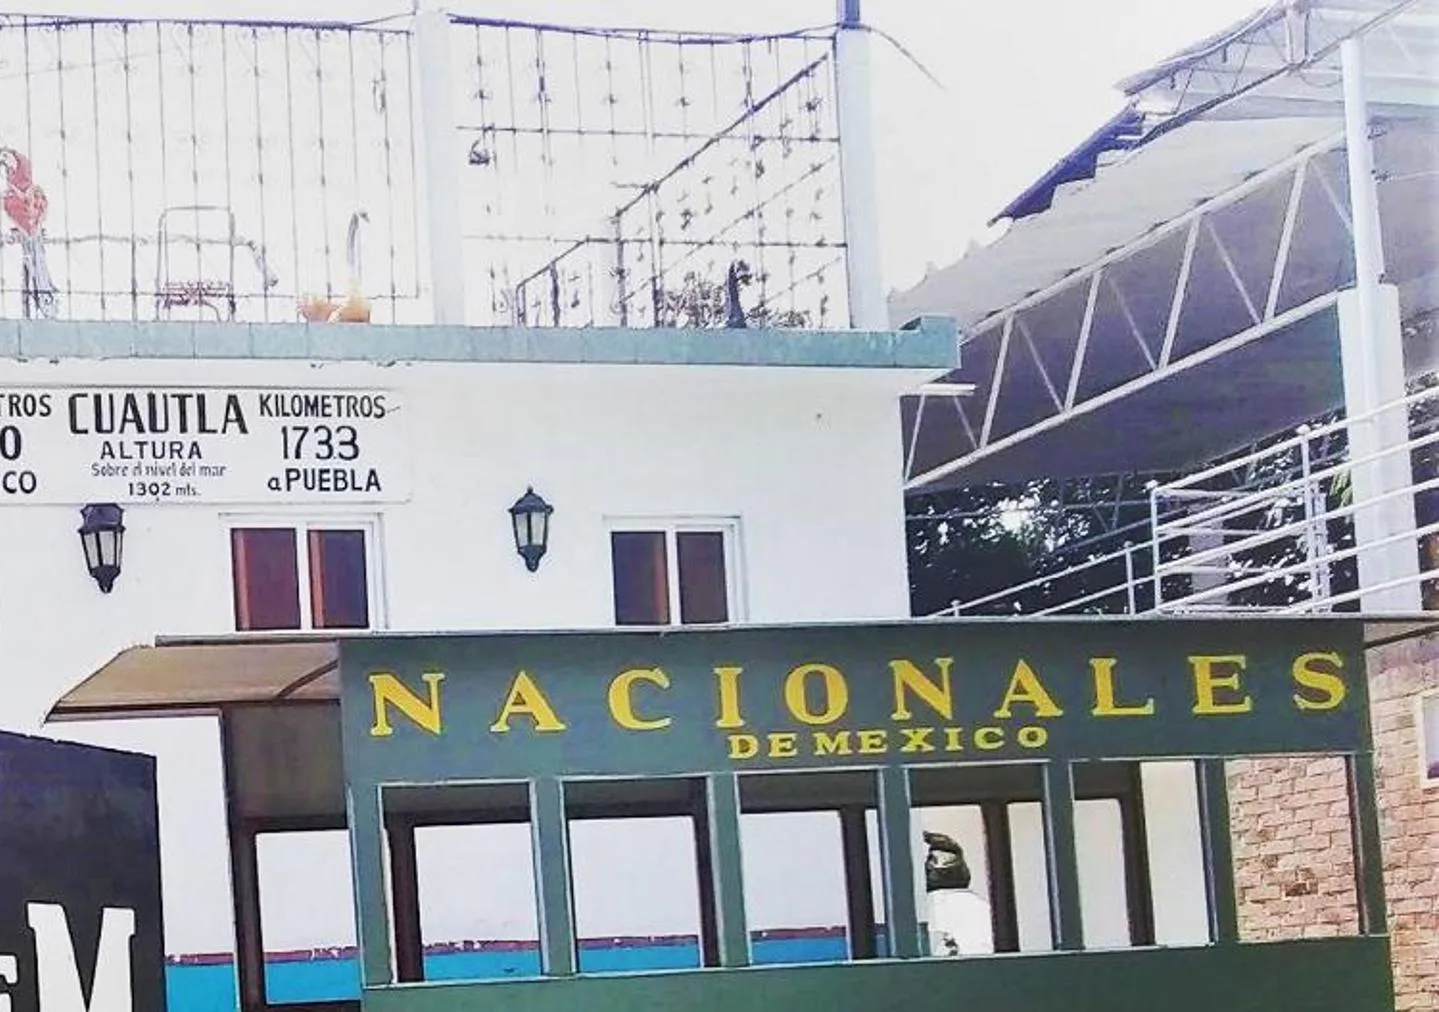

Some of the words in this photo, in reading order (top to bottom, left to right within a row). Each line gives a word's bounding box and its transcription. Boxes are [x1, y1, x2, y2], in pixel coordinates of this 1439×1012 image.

[68, 391, 249, 434] CUAUTLA
[259, 393, 386, 419] KILOMETROS
[100, 440, 203, 460] ALTURA
[91, 462, 129, 477] Sobre
[199, 466, 227, 477] mar
[284, 467, 382, 492] PUEBLA
[128, 482, 171, 497] 1302
[370, 651, 1347, 738] NACIONALES
[728, 731, 801, 760] DE
[812, 726, 1049, 755] MEXICO
